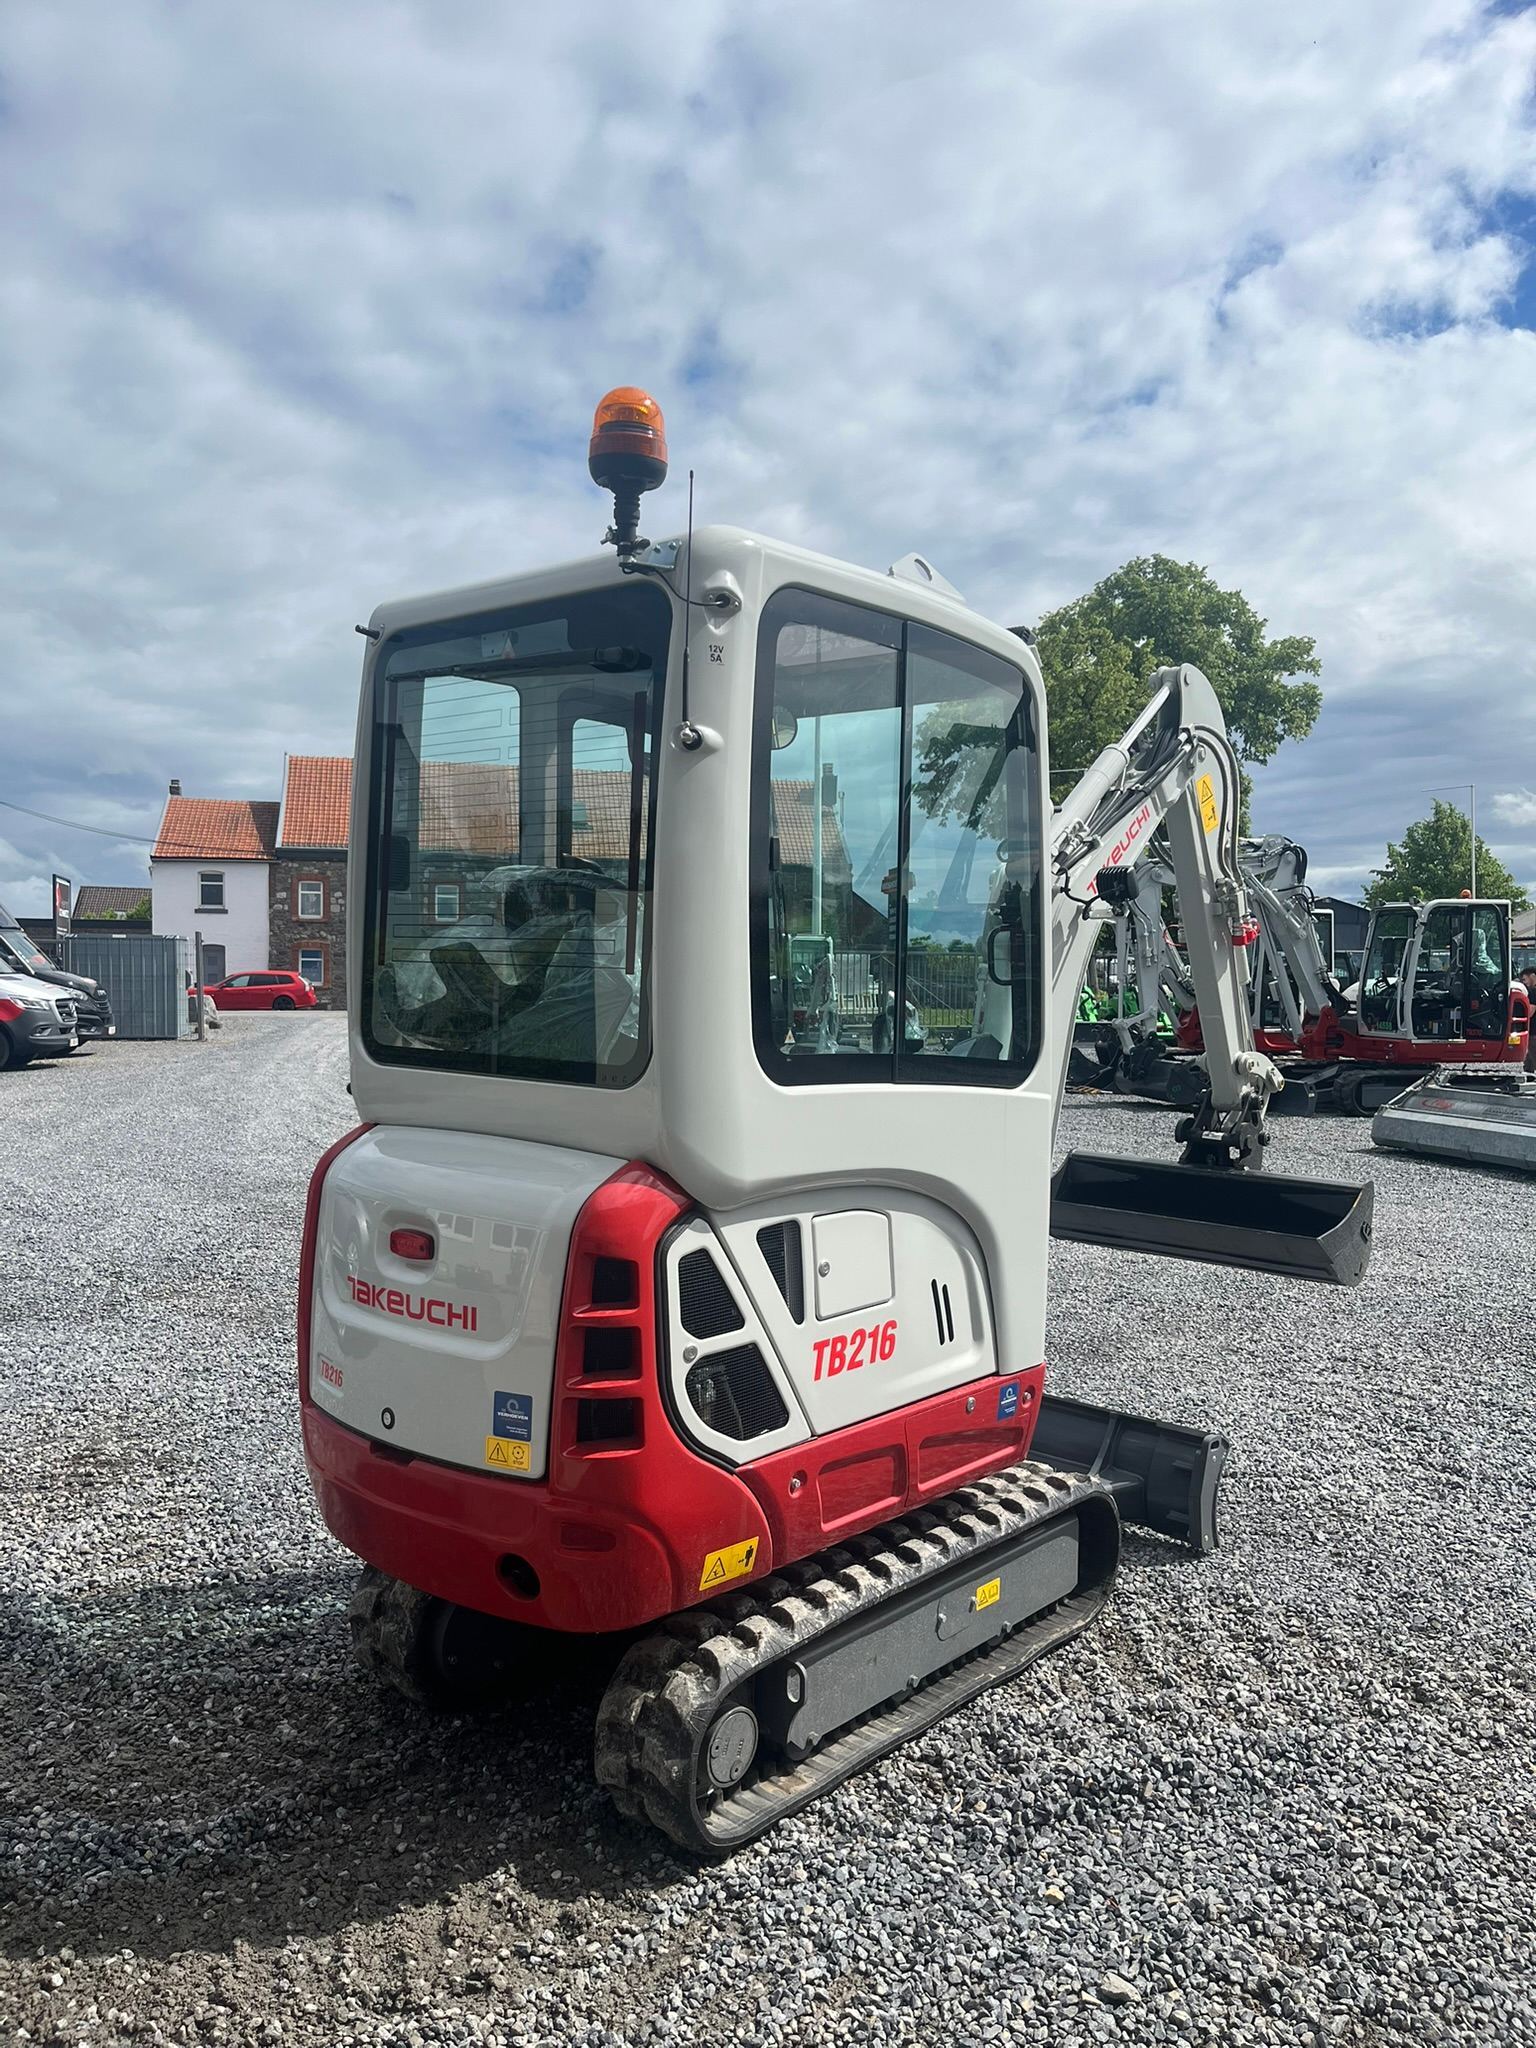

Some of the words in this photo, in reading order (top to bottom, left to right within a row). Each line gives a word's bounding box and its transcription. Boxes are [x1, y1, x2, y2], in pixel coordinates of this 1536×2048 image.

[709, 644, 724, 654] 12V
[710, 653, 723, 663] 5A
[813, 1319, 898, 1382] TB216
[321, 1359, 344, 1388] TB216
[497, 1411, 529, 1421] VERHOEVEN
